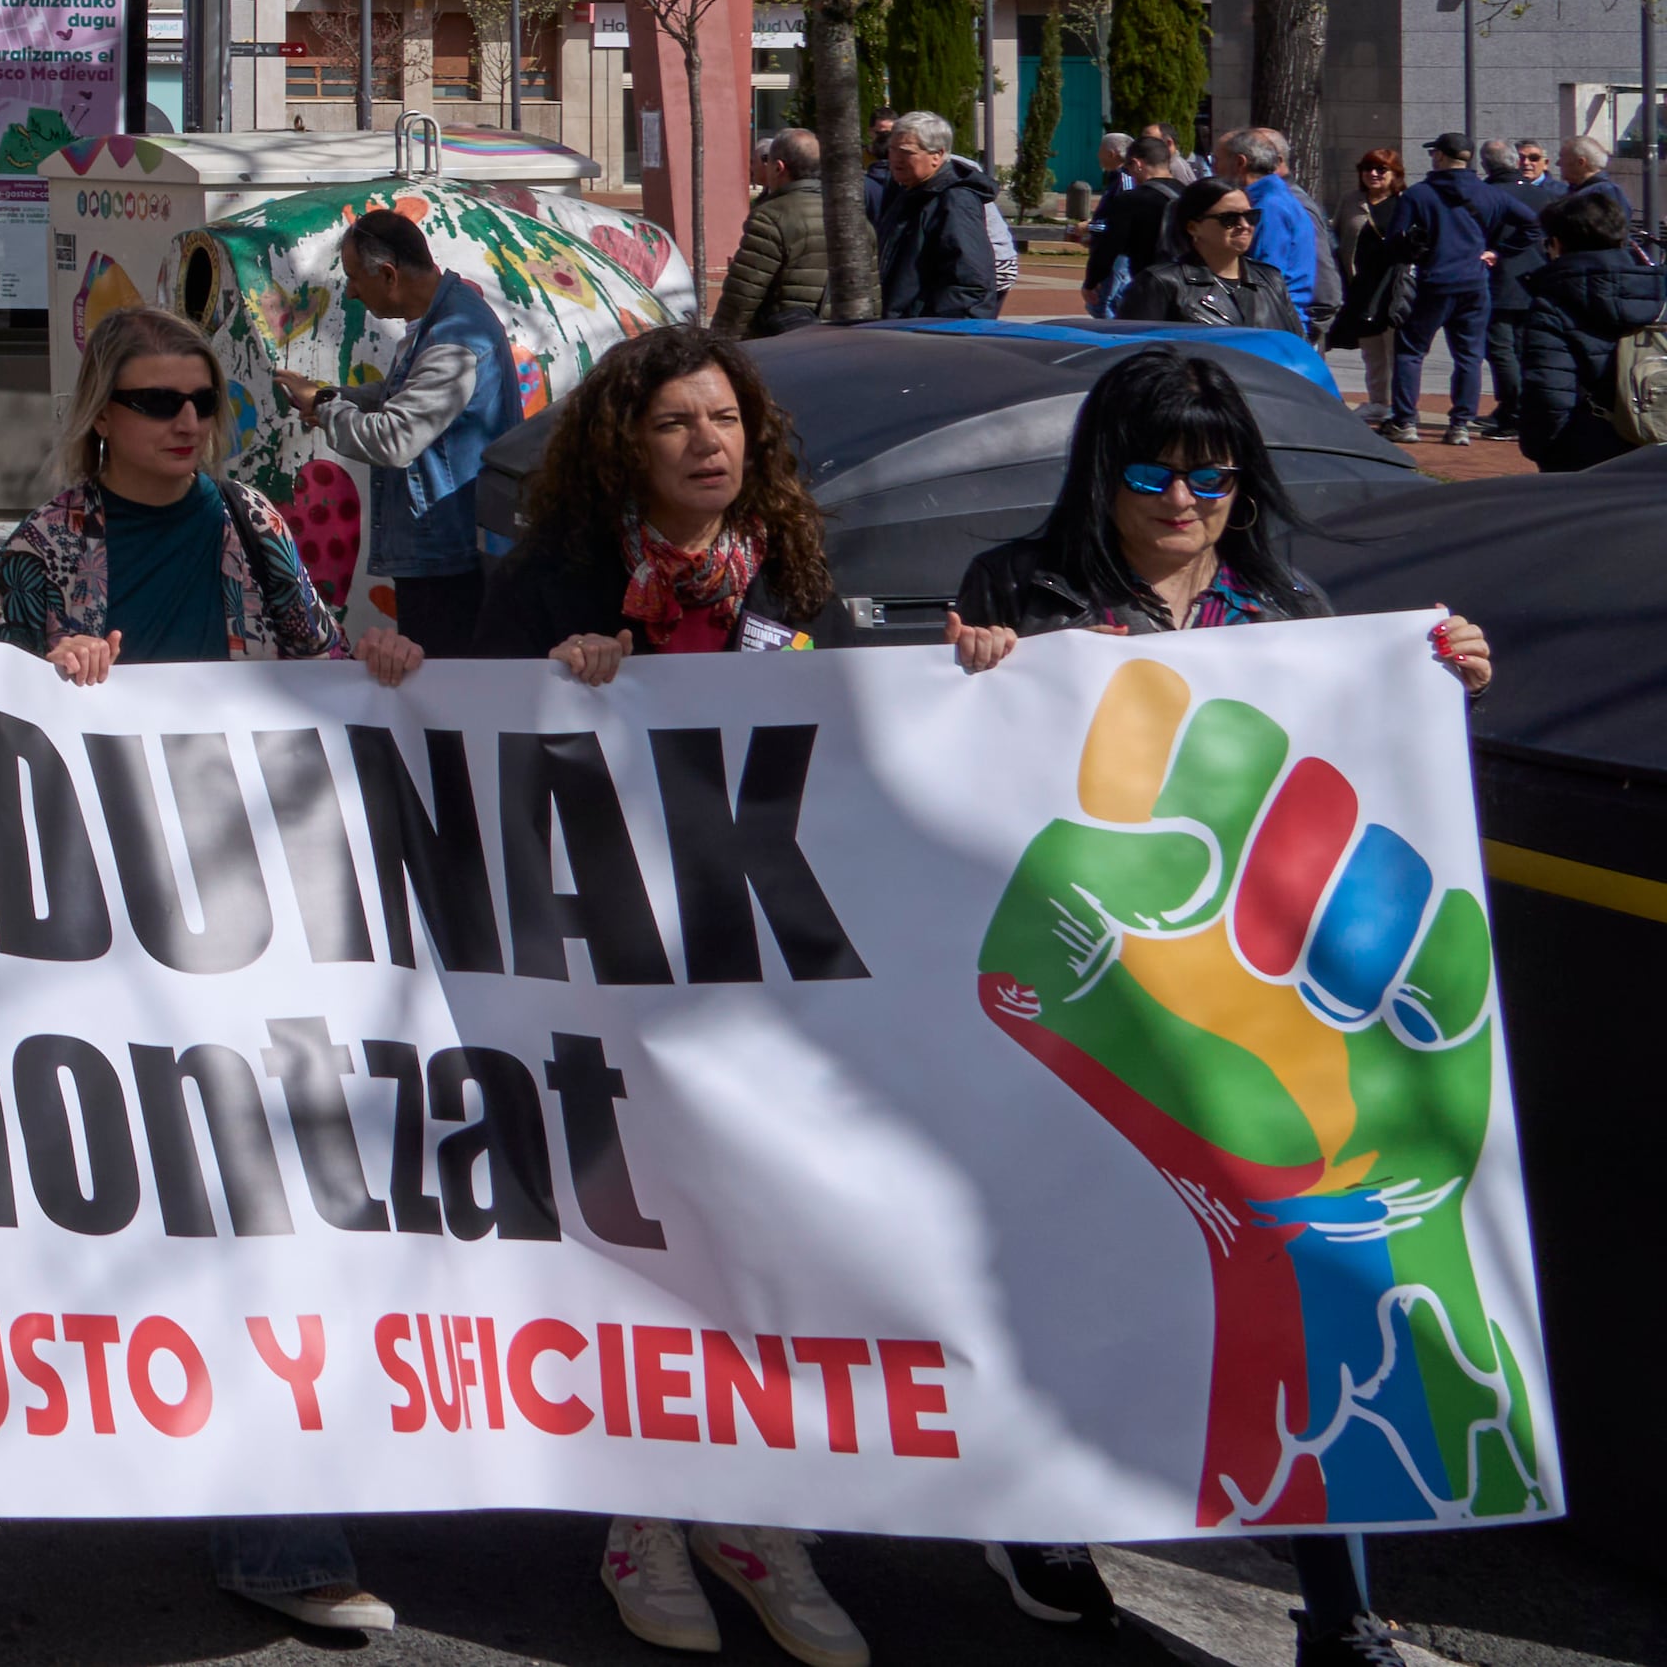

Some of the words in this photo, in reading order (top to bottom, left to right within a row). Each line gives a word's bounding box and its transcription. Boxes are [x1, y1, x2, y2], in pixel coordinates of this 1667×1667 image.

[68, 12, 116, 30] dugu
[97, 48, 115, 63] el
[30, 65, 114, 82] Medieval
[744, 623, 782, 646] DUINAK
[247, 1314, 326, 1432] Y
[375, 1314, 961, 1461] SUFICIENTE
